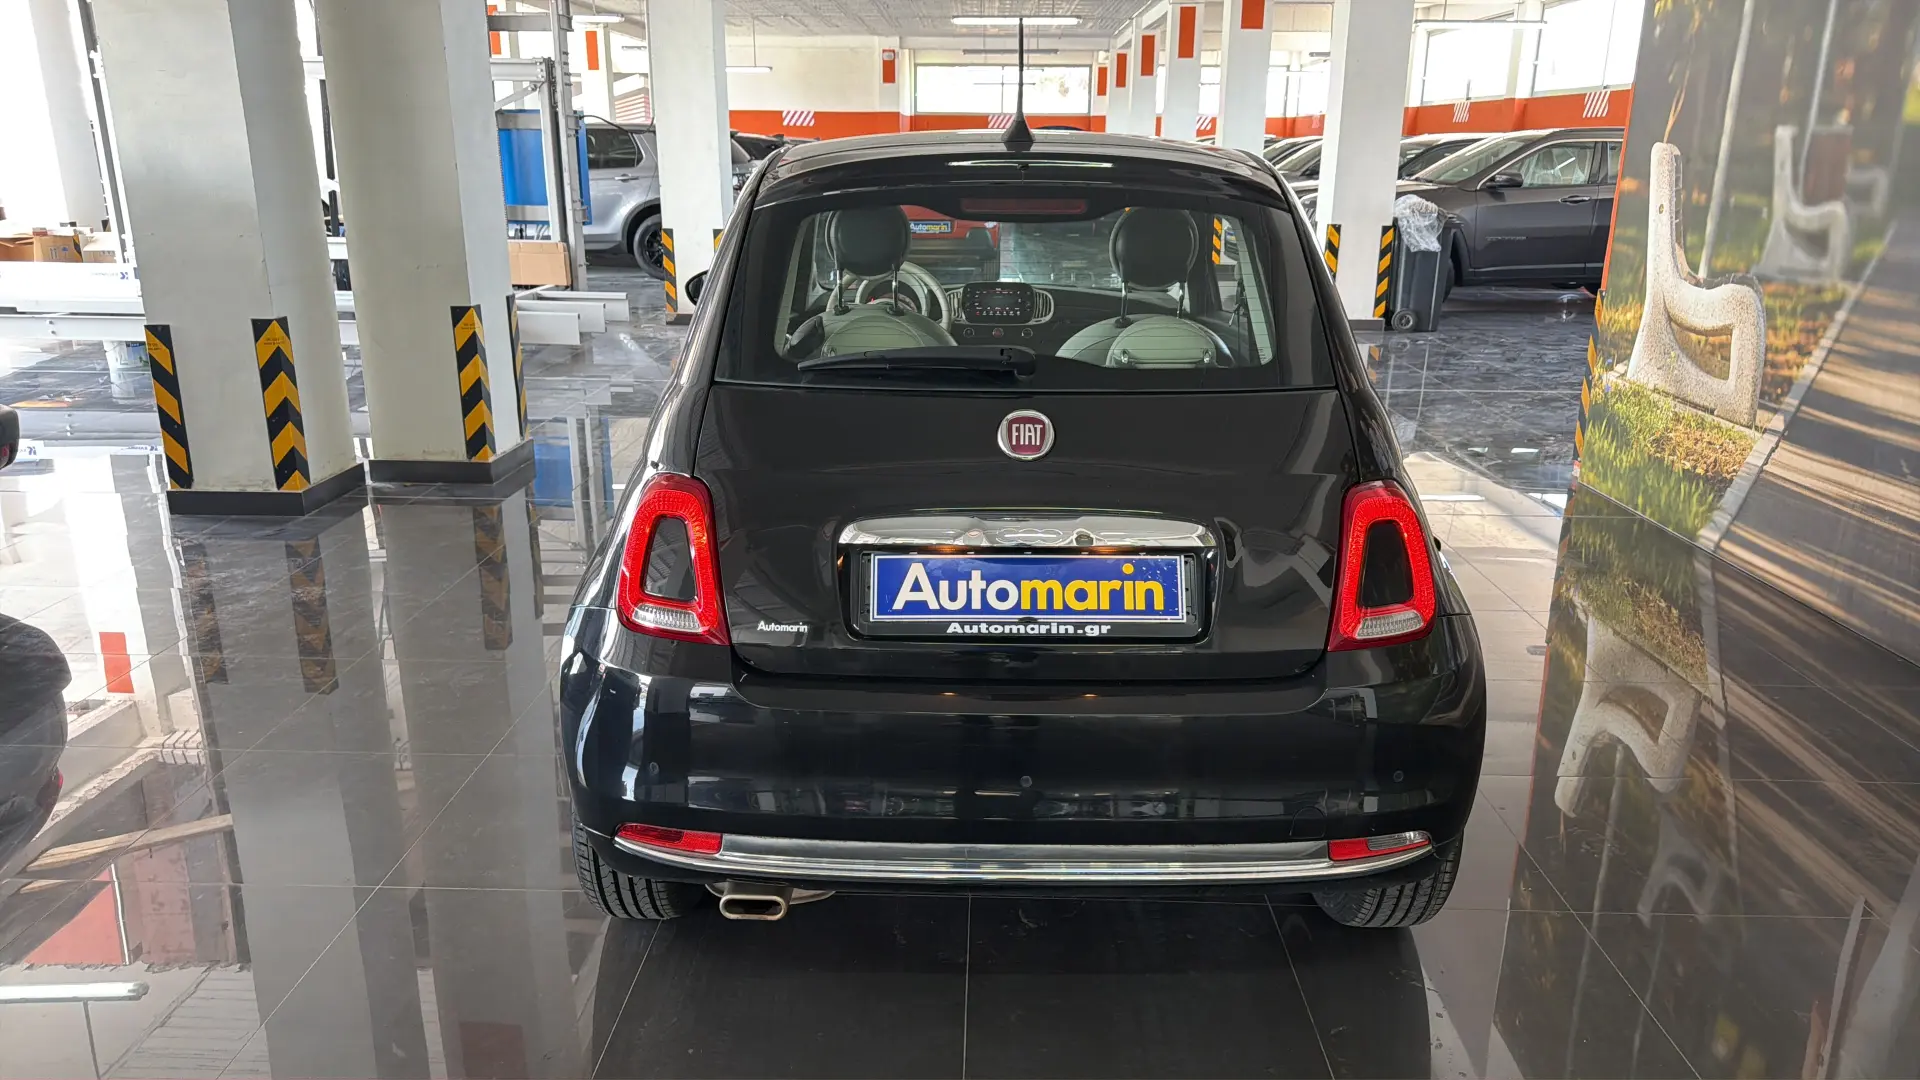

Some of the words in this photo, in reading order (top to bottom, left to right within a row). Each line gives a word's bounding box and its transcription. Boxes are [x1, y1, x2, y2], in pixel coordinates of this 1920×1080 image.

[910, 222, 948, 231] Automarin
[1011, 423, 1043, 445] FIAT
[891, 562, 1164, 611] Automarin
[757, 620, 808, 633] Automarin
[946, 622, 1111, 636] Automarin.gr
